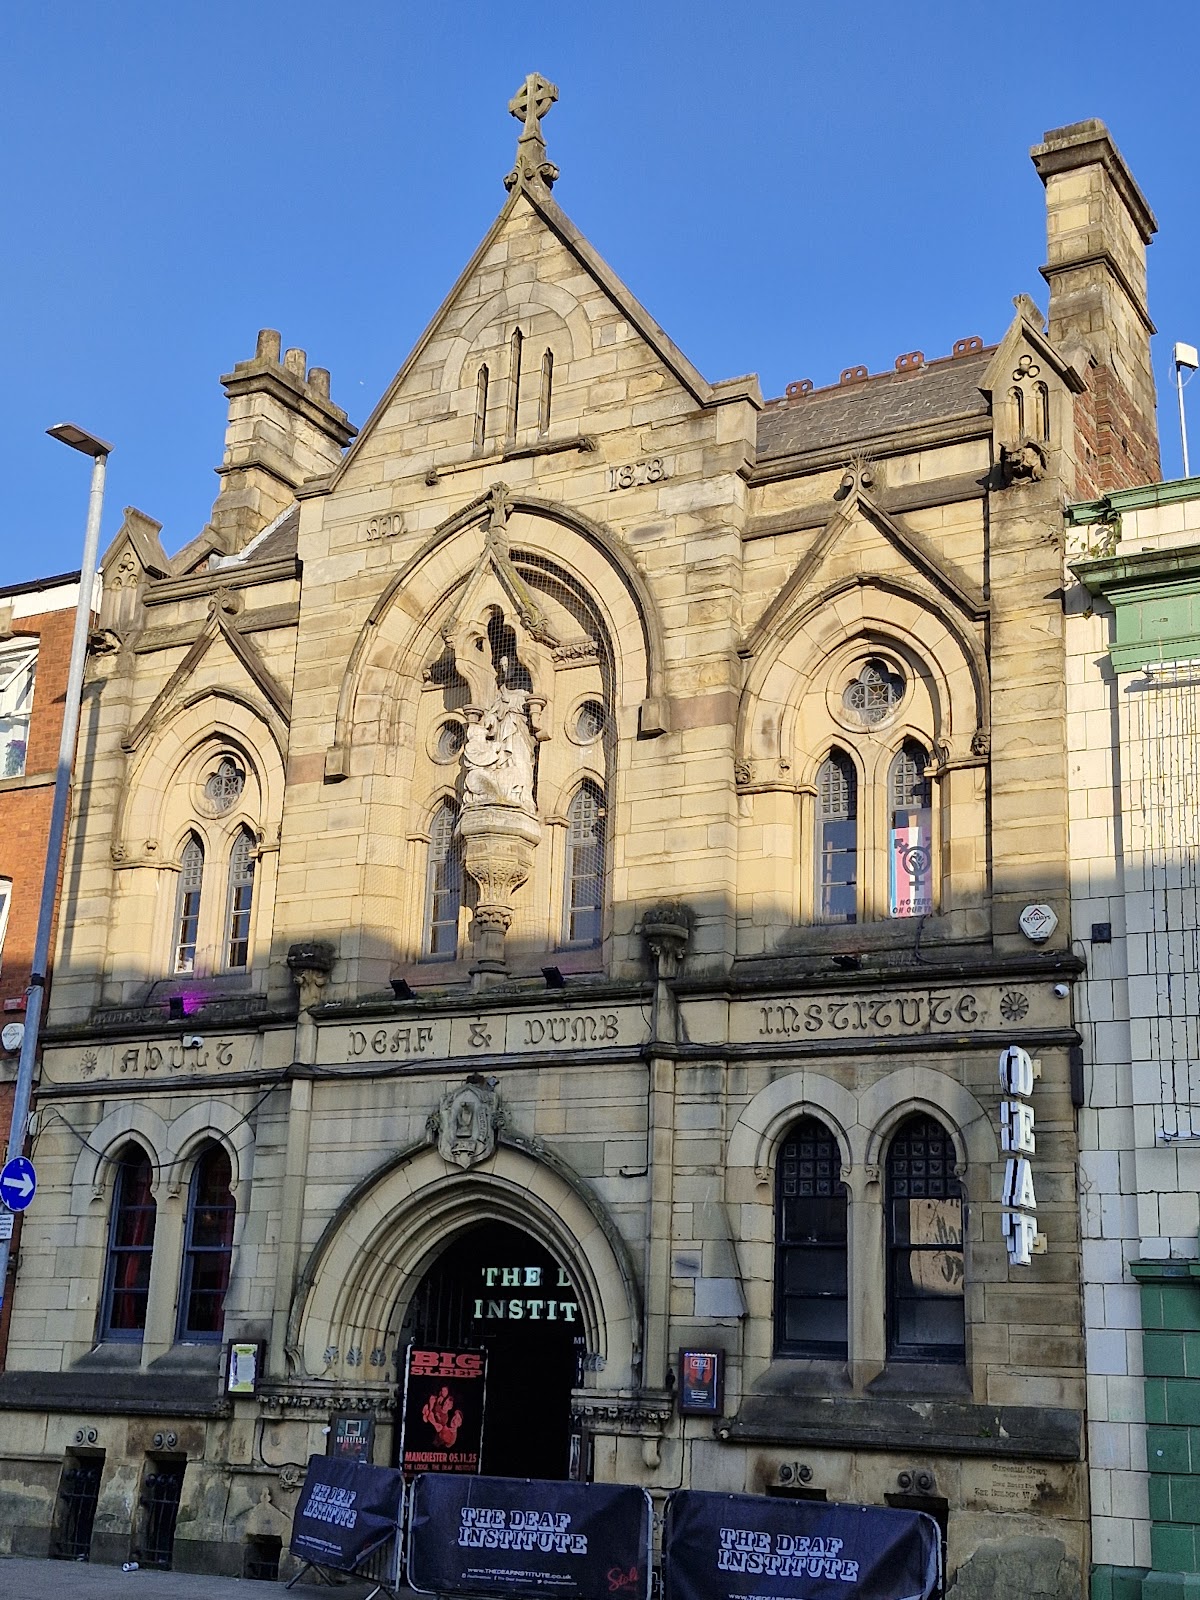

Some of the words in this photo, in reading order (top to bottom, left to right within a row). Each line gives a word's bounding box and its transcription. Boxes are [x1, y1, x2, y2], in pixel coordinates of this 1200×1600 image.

[892, 906, 904, 914] ON
[906, 906, 922, 914] OUR
[900, 898, 911, 906] NO
[758, 994, 977, 1036] INSTITUTE
[347, 1026, 434, 1057] DEAF
[467, 1022, 492, 1049] &
[524, 1013, 620, 1045] DUMB
[119, 1041, 234, 1073] ADULT
[1000, 1045, 1038, 1266] DEAF
[481, 1266, 542, 1287] THE
[410, 1350, 484, 1370] BIG
[410, 1366, 483, 1378] SLEEP
[404, 1451, 448, 1463] MANCHESTER
[449, 1452, 477, 1463] 05.11.25
[311, 1482, 331, 1503] THE
[327, 1486, 357, 1509] DEAF
[302, 1498, 358, 1529] INSTITUTE
[461, 1507, 506, 1529] THE
[509, 1510, 571, 1533] DEAF
[458, 1526, 588, 1555] INSTITUTE
[719, 1527, 772, 1553] THE
[776, 1533, 844, 1558] DEAF
[467, 1567, 572, 1580] www.THEDEAFINSTITUTE.co.uk
[717, 1548, 860, 1582] INSTITUTE
